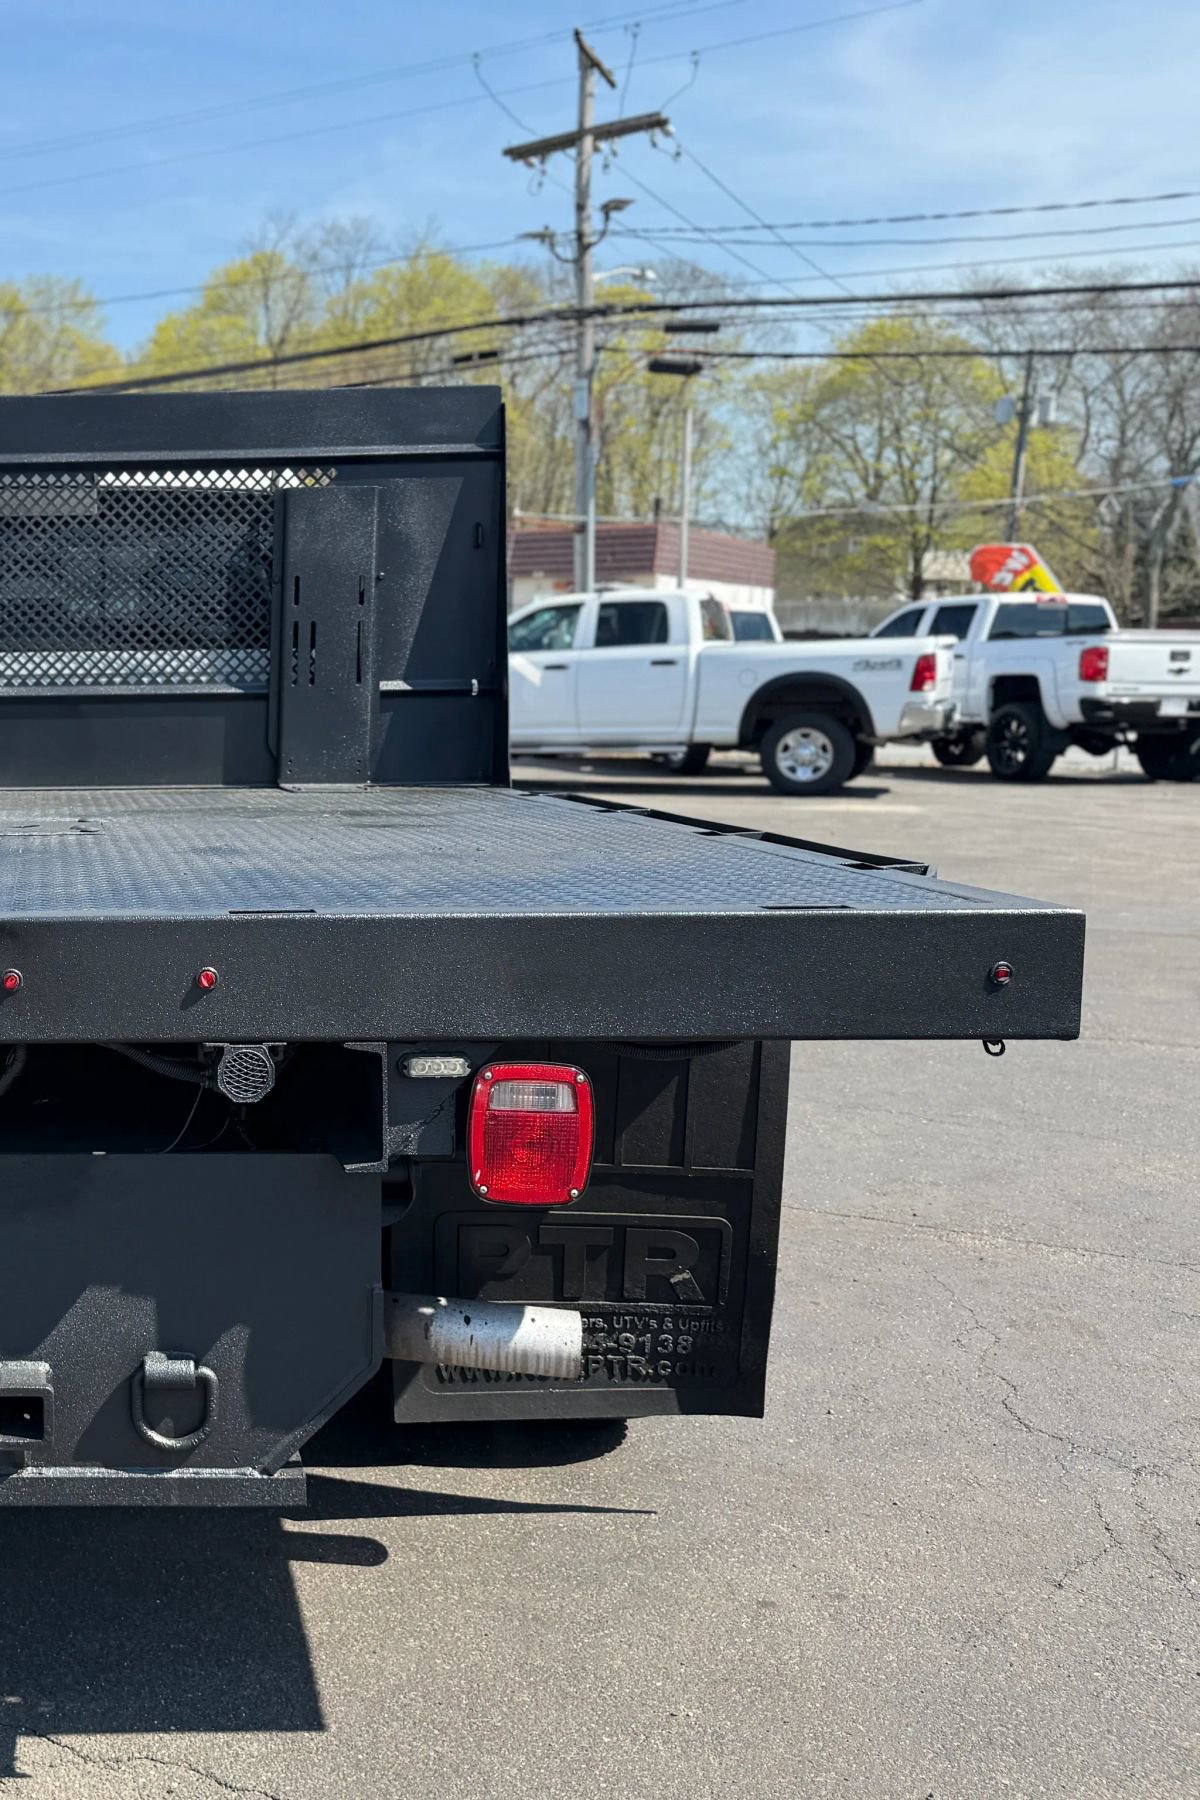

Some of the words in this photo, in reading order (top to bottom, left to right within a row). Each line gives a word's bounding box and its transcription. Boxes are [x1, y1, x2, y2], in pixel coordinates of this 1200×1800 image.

[457, 1224, 705, 1301] PTR
[612, 1315, 657, 1331] UTV's
[662, 1316, 674, 1331] &
